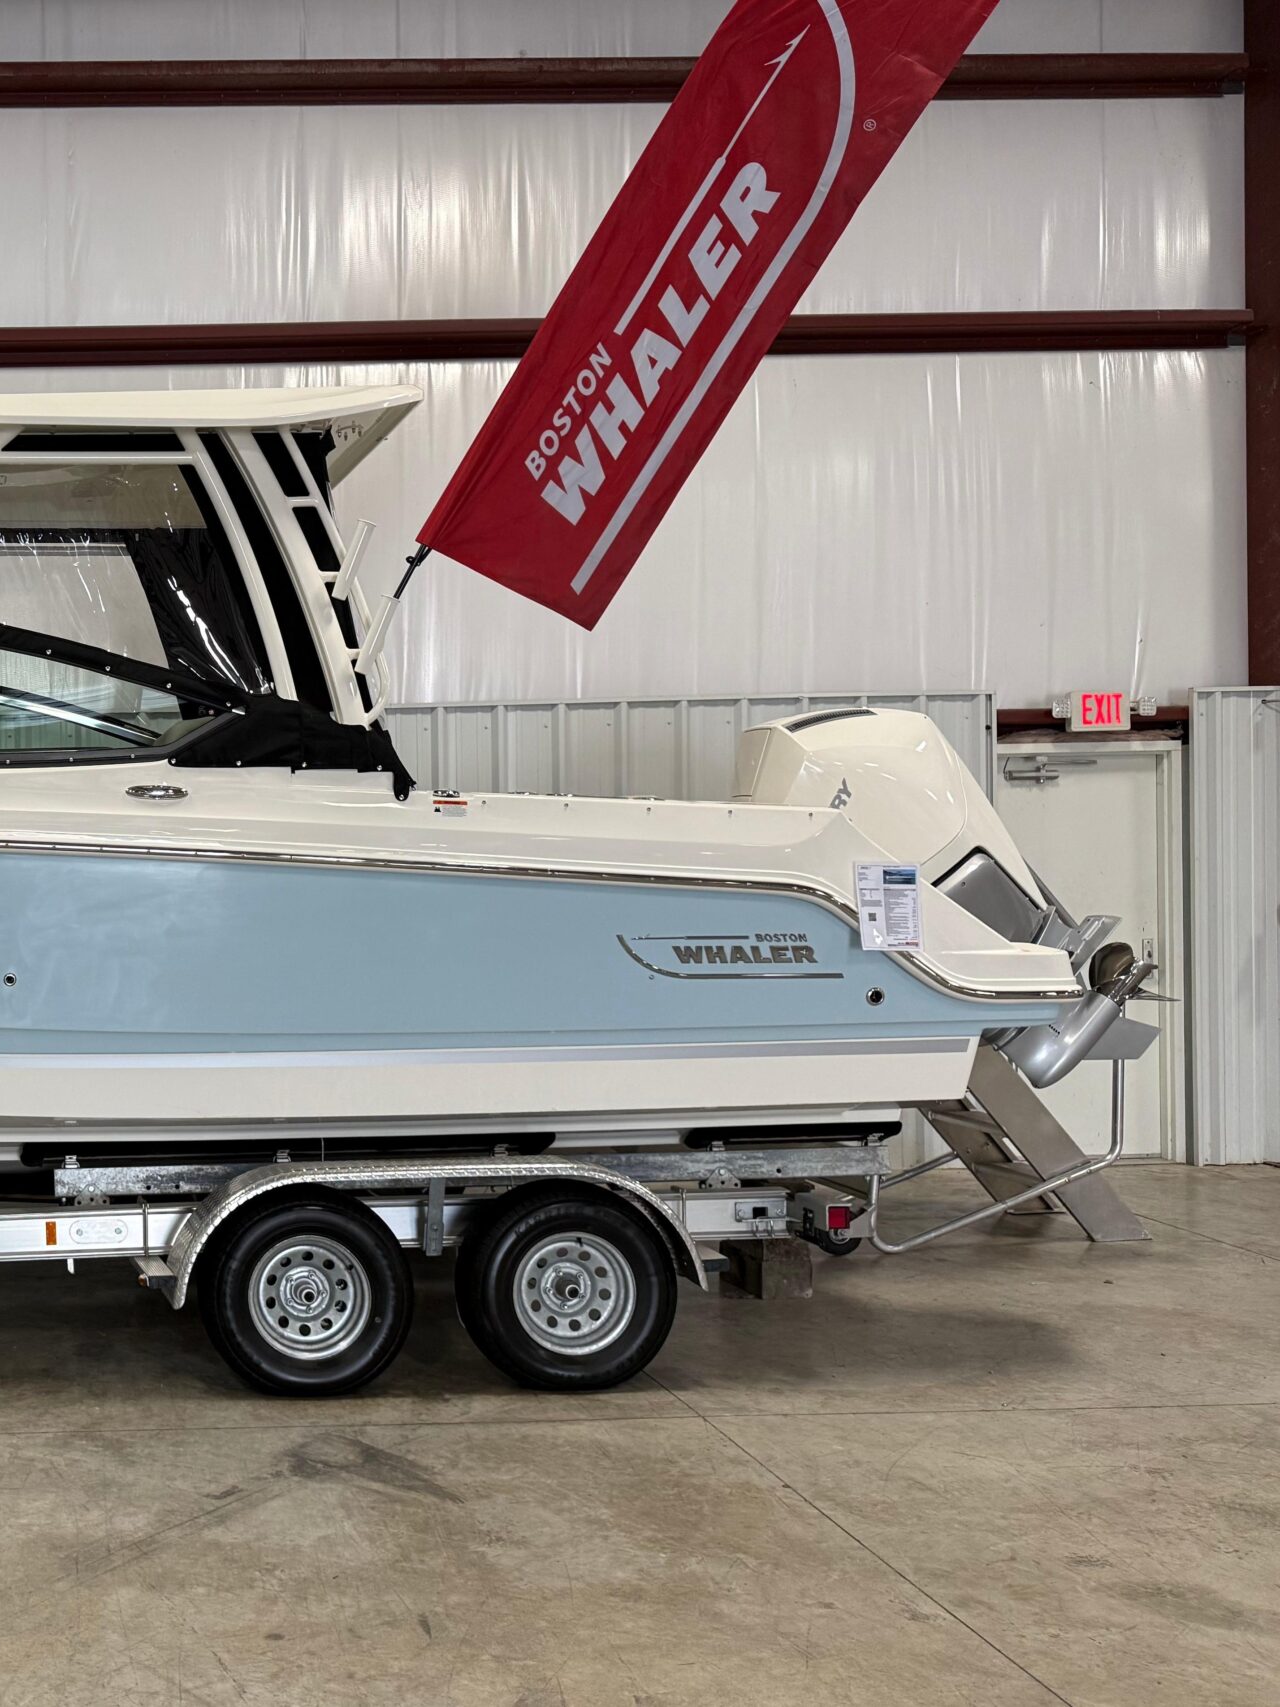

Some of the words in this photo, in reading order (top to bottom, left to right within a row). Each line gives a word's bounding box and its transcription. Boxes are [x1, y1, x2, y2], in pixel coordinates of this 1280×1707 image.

[540, 161, 782, 526] WHALER
[524, 341, 613, 481] BOSTON
[1081, 693, 1123, 726] EXIT
[754, 932, 808, 943] BOSTON
[671, 945, 819, 965] WHALER
